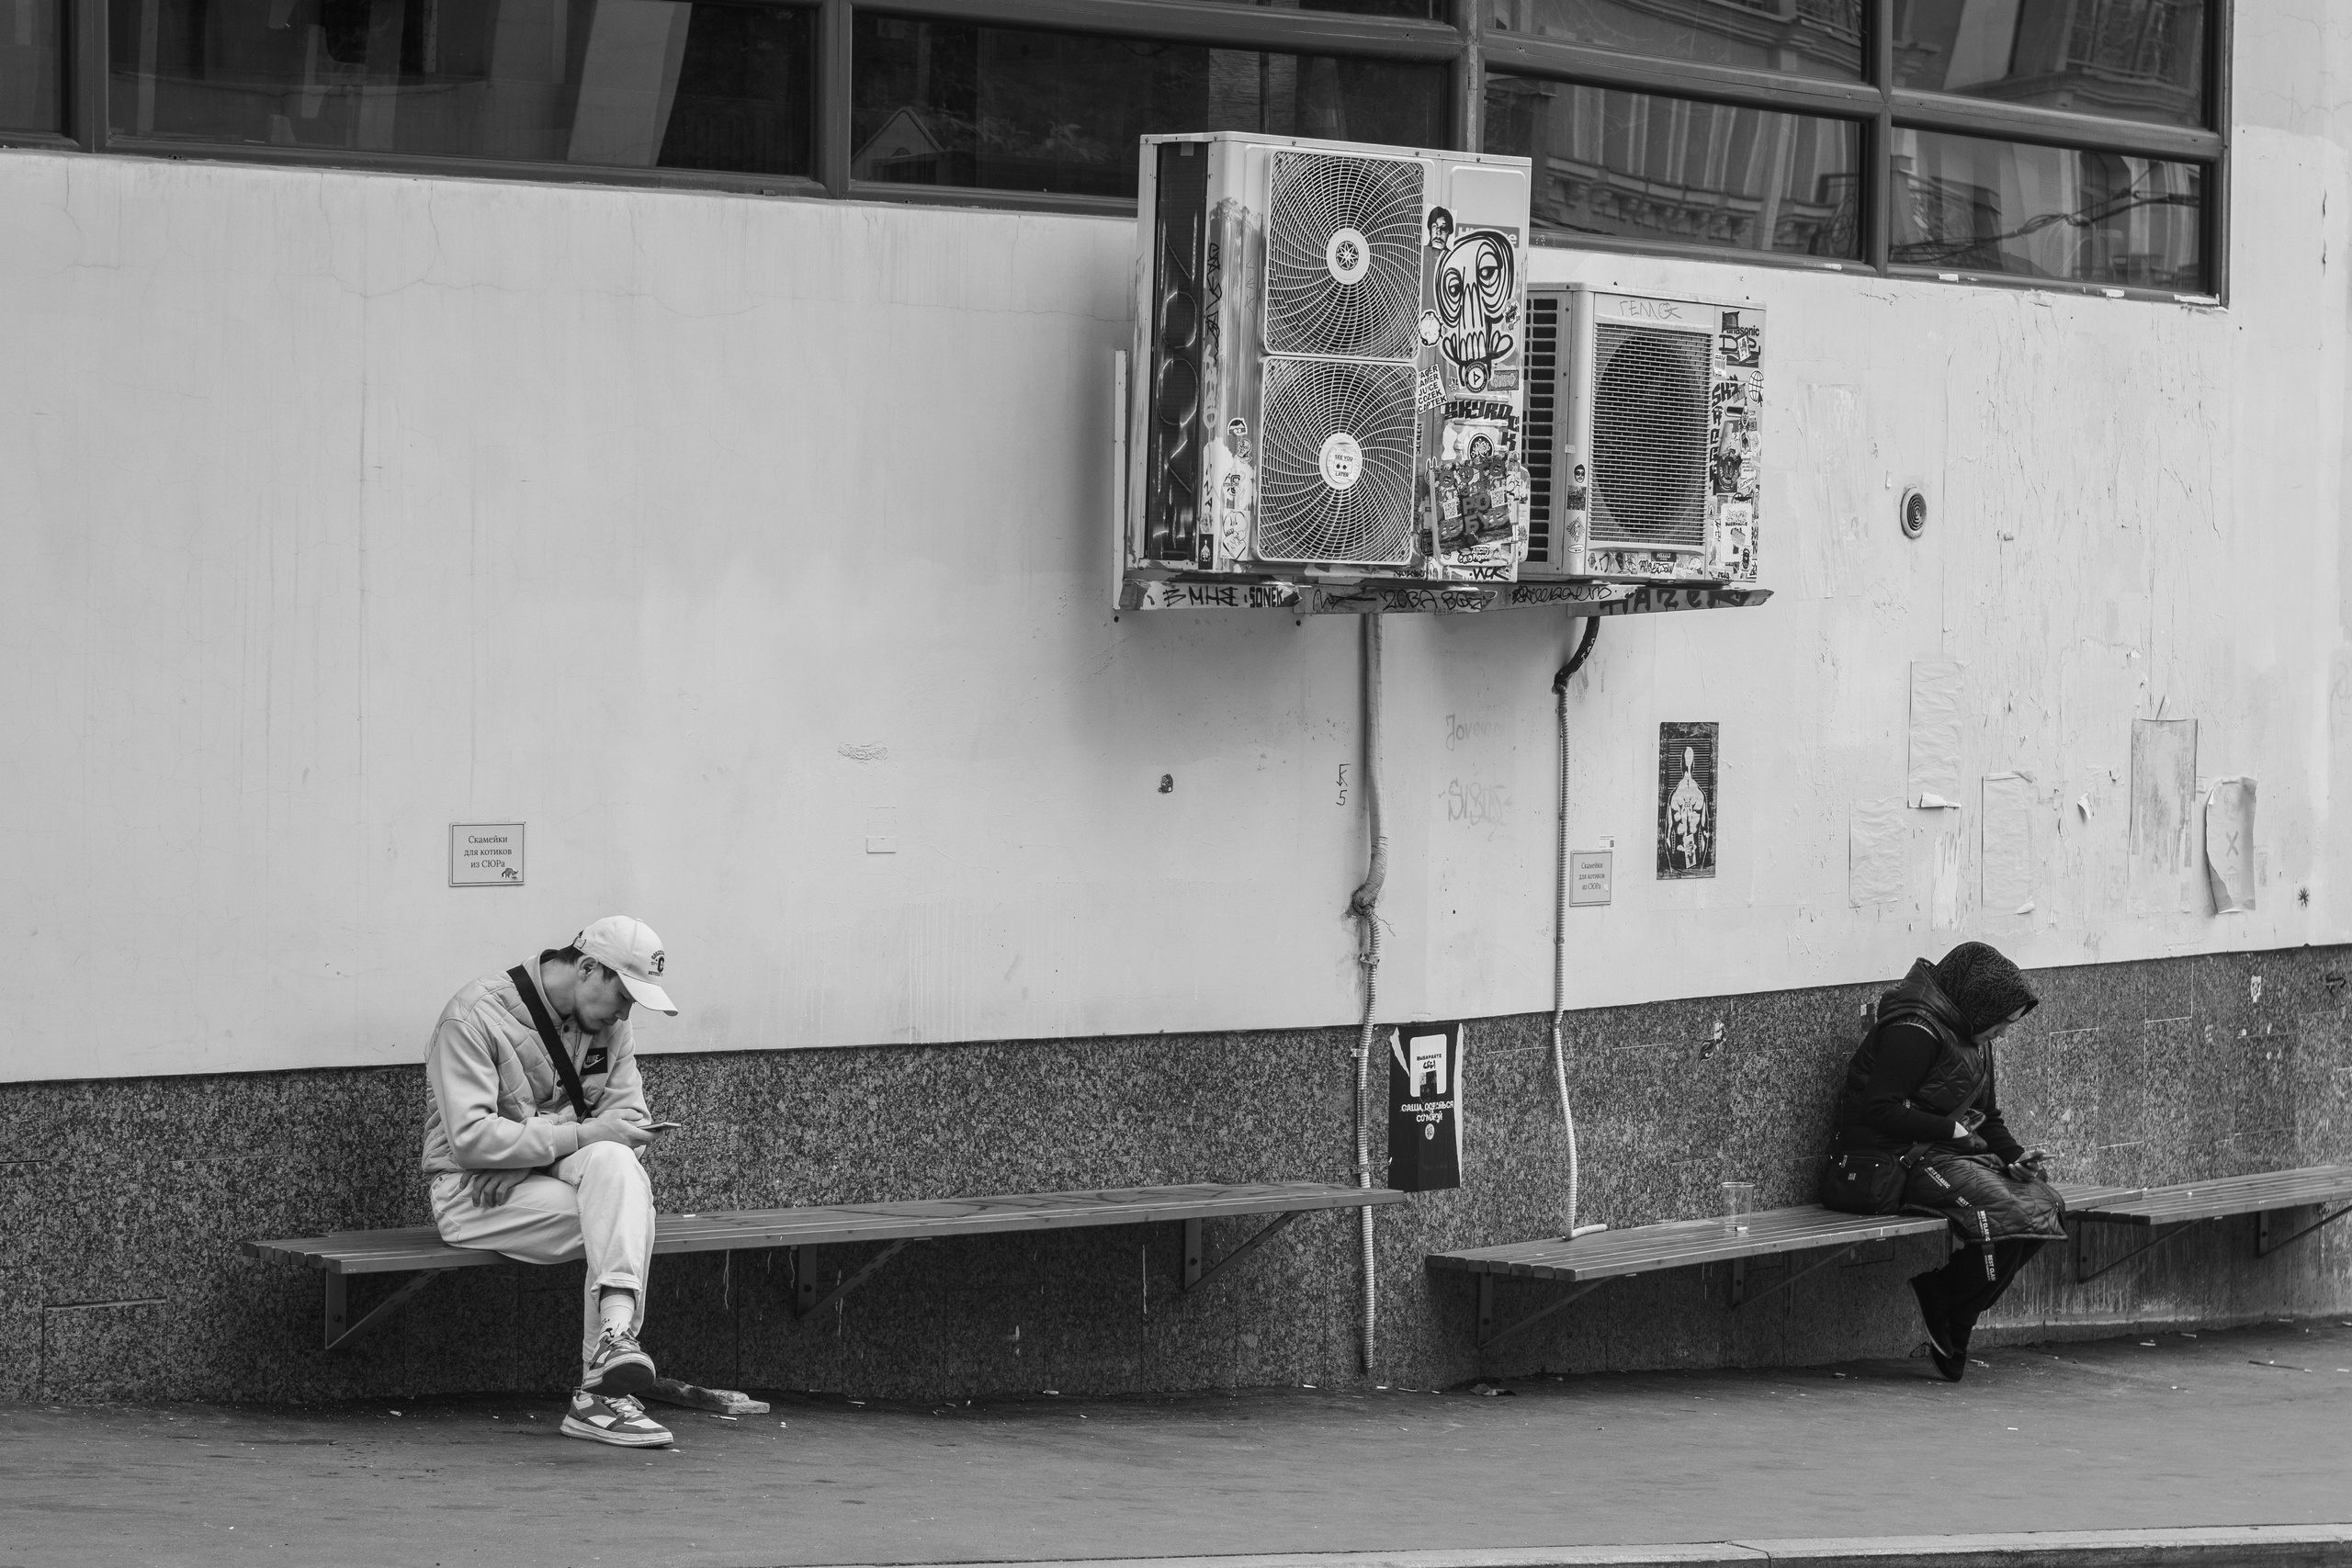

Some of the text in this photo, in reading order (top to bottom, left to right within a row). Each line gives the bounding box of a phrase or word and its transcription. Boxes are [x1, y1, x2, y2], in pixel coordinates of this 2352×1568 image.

[468, 835, 508, 844] Скамейки
[463, 848, 513, 857] для котиков
[481, 860, 505, 868] СЮРа
[587, 1055, 600, 1065] NIKE
